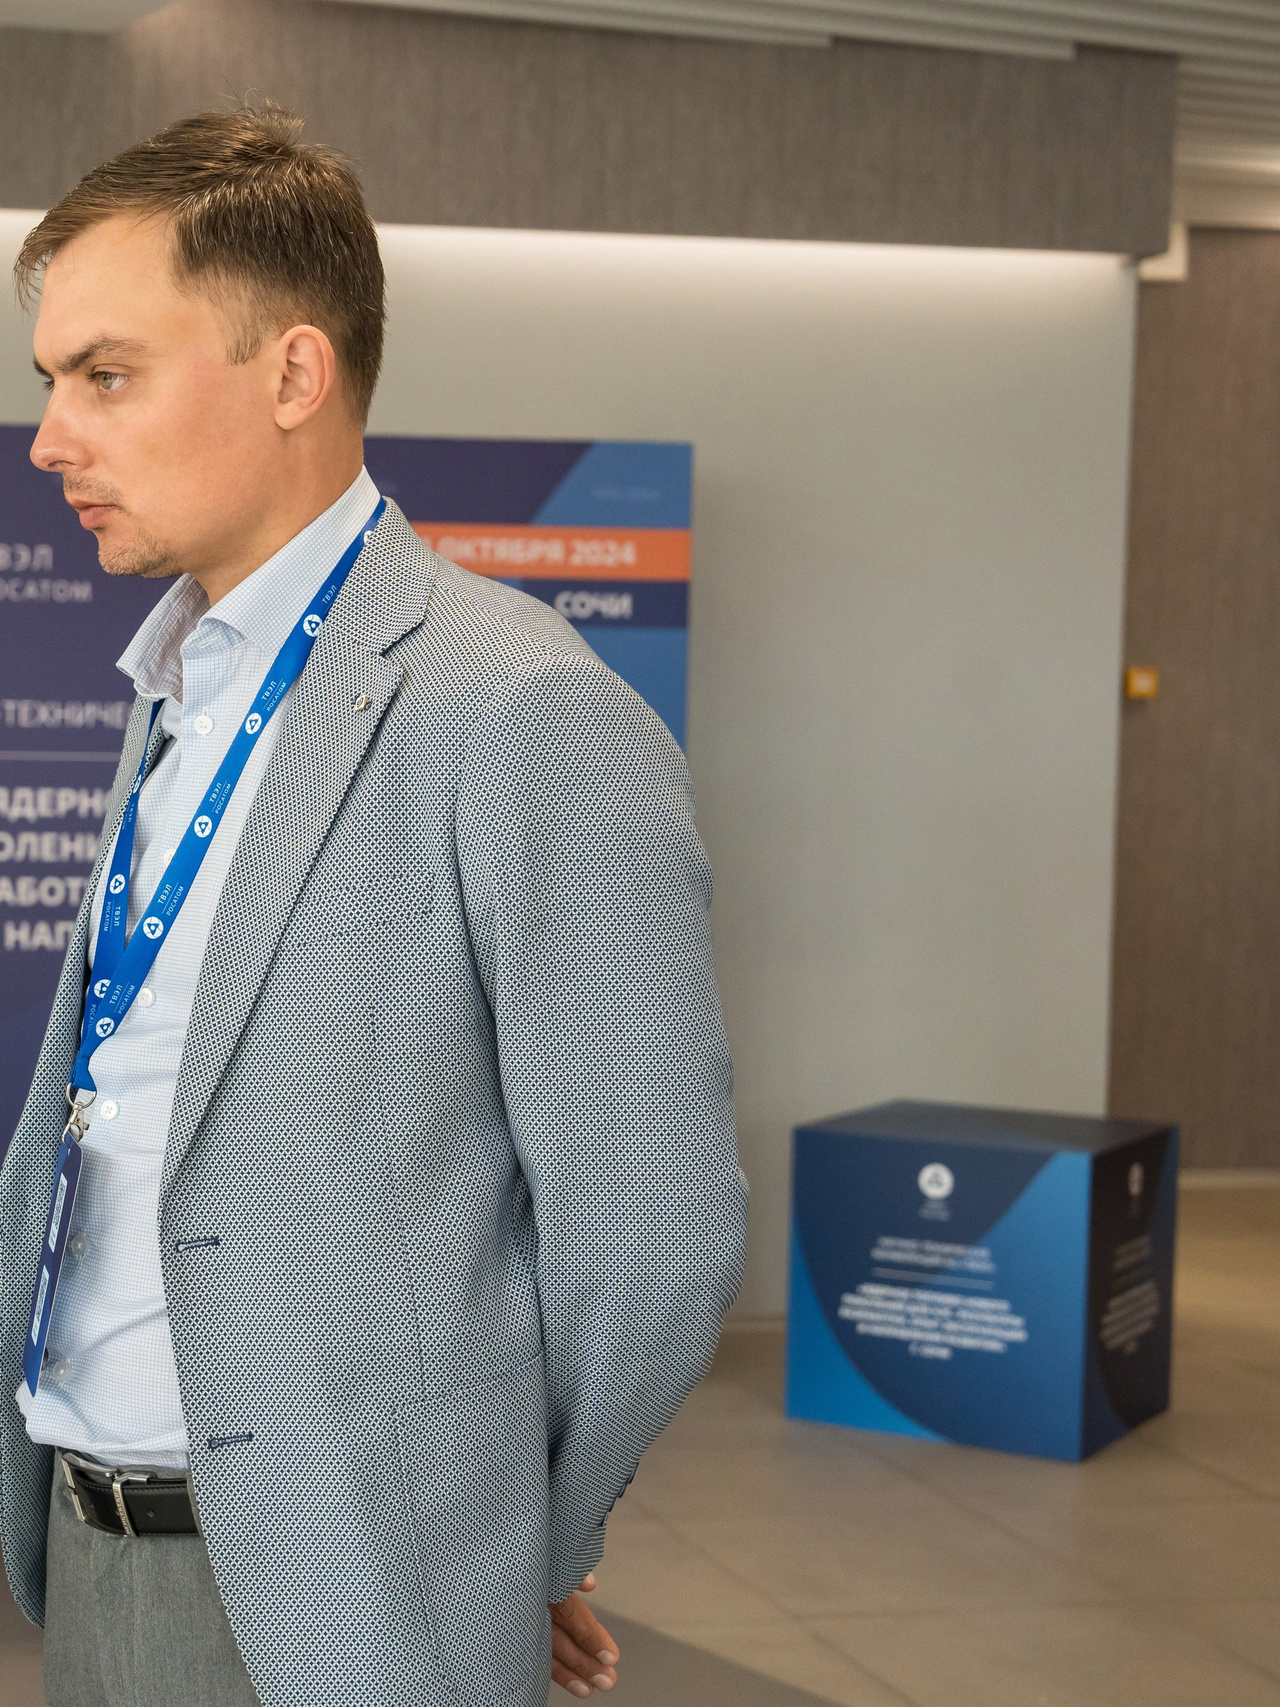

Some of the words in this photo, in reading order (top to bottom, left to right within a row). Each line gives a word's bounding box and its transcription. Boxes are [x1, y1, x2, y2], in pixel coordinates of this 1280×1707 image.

[570, 539, 637, 567] 2024
[322, 584, 338, 604] ТВЭЛ
[554, 591, 634, 619] СОЧИ
[261, 680, 277, 701] ТВЭЛ
[266, 681, 287, 712] РОСАТОМ
[209, 782, 222, 803] ТВЭЛ
[215, 783, 232, 815] РОСАТОМ
[157, 883, 173, 905] ТВЭЛ
[166, 885, 185, 917] РОСАТОМ
[103, 901, 112, 932] РОСАТОМ
[109, 984, 123, 1005] ТВЭЛ
[117, 985, 136, 1015] РОСАТОМ
